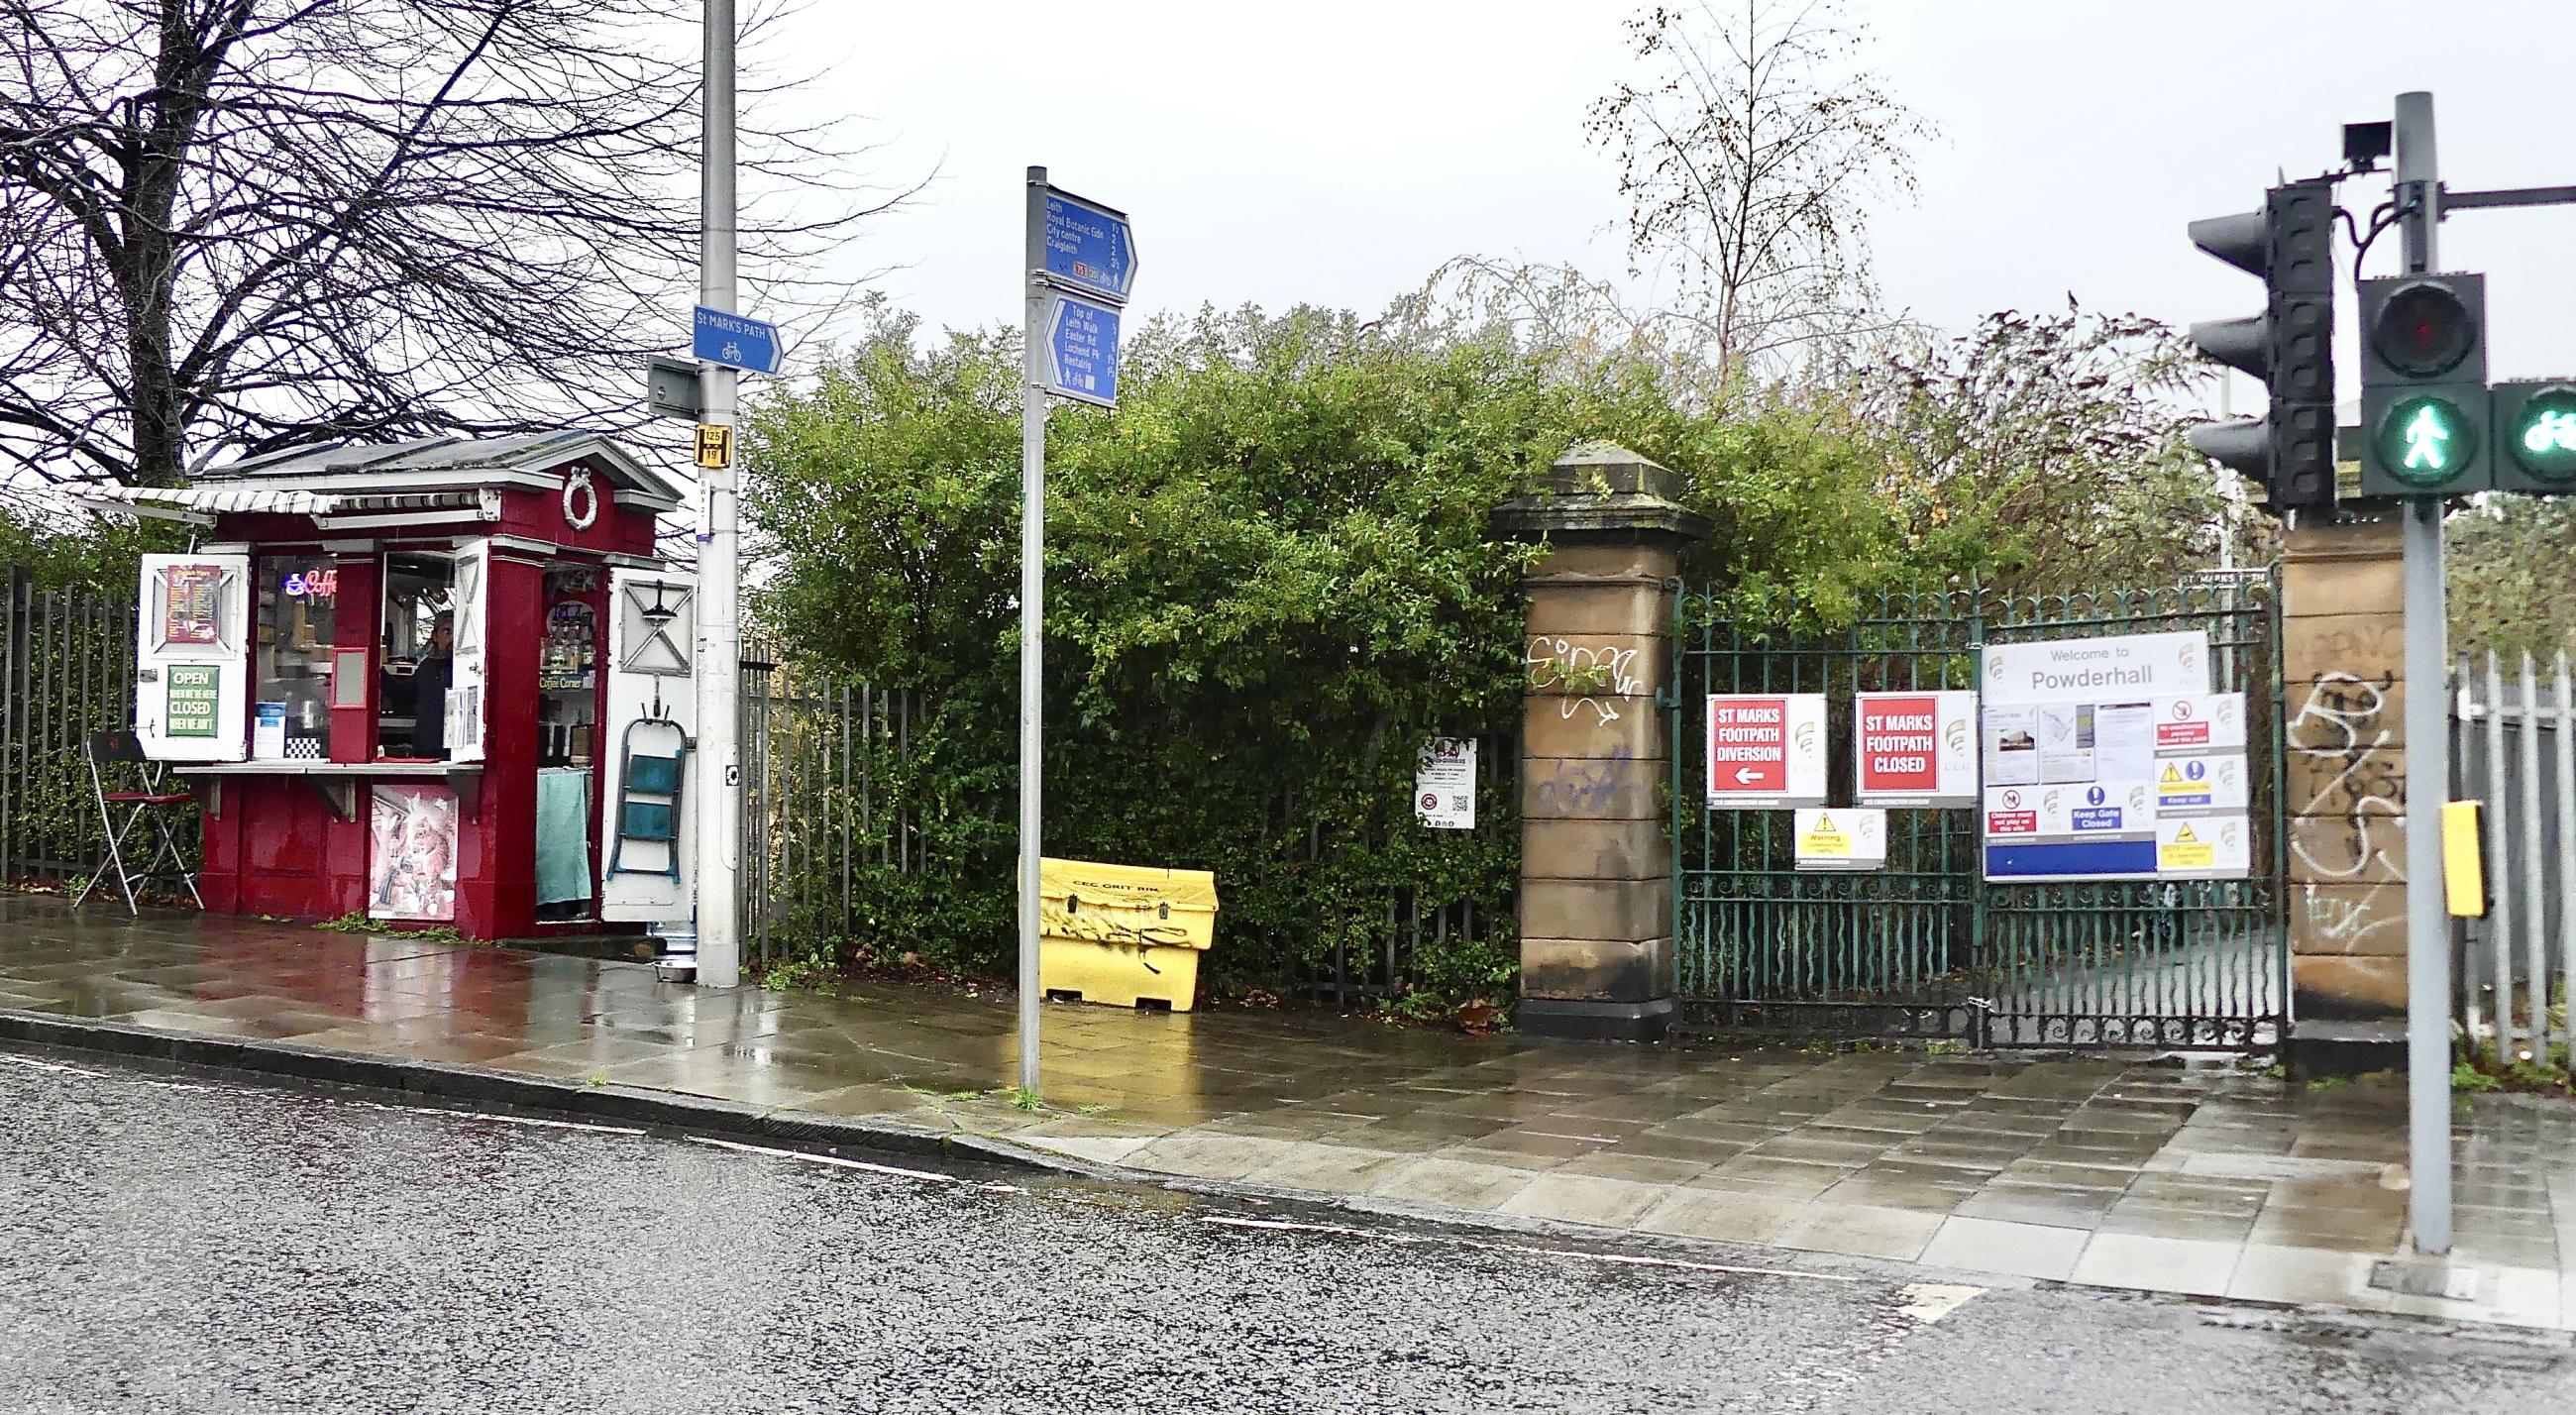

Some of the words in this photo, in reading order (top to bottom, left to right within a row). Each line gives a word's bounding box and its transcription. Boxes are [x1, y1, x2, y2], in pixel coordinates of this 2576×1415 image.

[1046, 198, 1063, 214] Leith
[1046, 210, 1065, 228] Royal
[1066, 217, 1091, 236] Botanic
[1046, 223, 1060, 239] City
[1060, 230, 1082, 245] centre
[1111, 246, 1117, 257] 2
[1046, 236, 1078, 256] Craigleith
[1072, 305, 1085, 319] Top
[1086, 310, 1094, 321] of
[697, 311, 707, 326] St
[708, 315, 742, 334] MARK'S
[744, 323, 766, 340] PATH
[1065, 315, 1082, 330] Leith
[1083, 320, 1099, 335] Walk
[1065, 328, 1086, 344] Easter
[1087, 334, 1096, 347] Rd
[1064, 341, 1090, 358] Lochend
[1091, 348, 1100, 361] Pk
[1064, 354, 1092, 374] Restalrig
[705, 431, 720, 441] 125
[2050, 648, 2109, 662] Welcome
[2116, 647, 2129, 658] to
[173, 672, 210, 685] OPEN
[560, 677, 582, 689] Corner
[2032, 665, 2153, 690] Powderhall
[170, 701, 211, 714] CLOSED
[1718, 708, 1735, 723] ST
[1736, 708, 1780, 723] MARKS
[1866, 715, 1883, 731] ST
[1885, 714, 1933, 731] MARKS
[1718, 727, 1779, 743] FOOTPATH
[1866, 735, 1933, 752] FOOTPATH
[1716, 746, 1781, 762] DIVERSION
[1874, 756, 1926, 773] CLOSED
[2167, 796, 2187, 805] Keep
[2097, 809, 2119, 817] Gate
[2082, 818, 2112, 828] Closed
